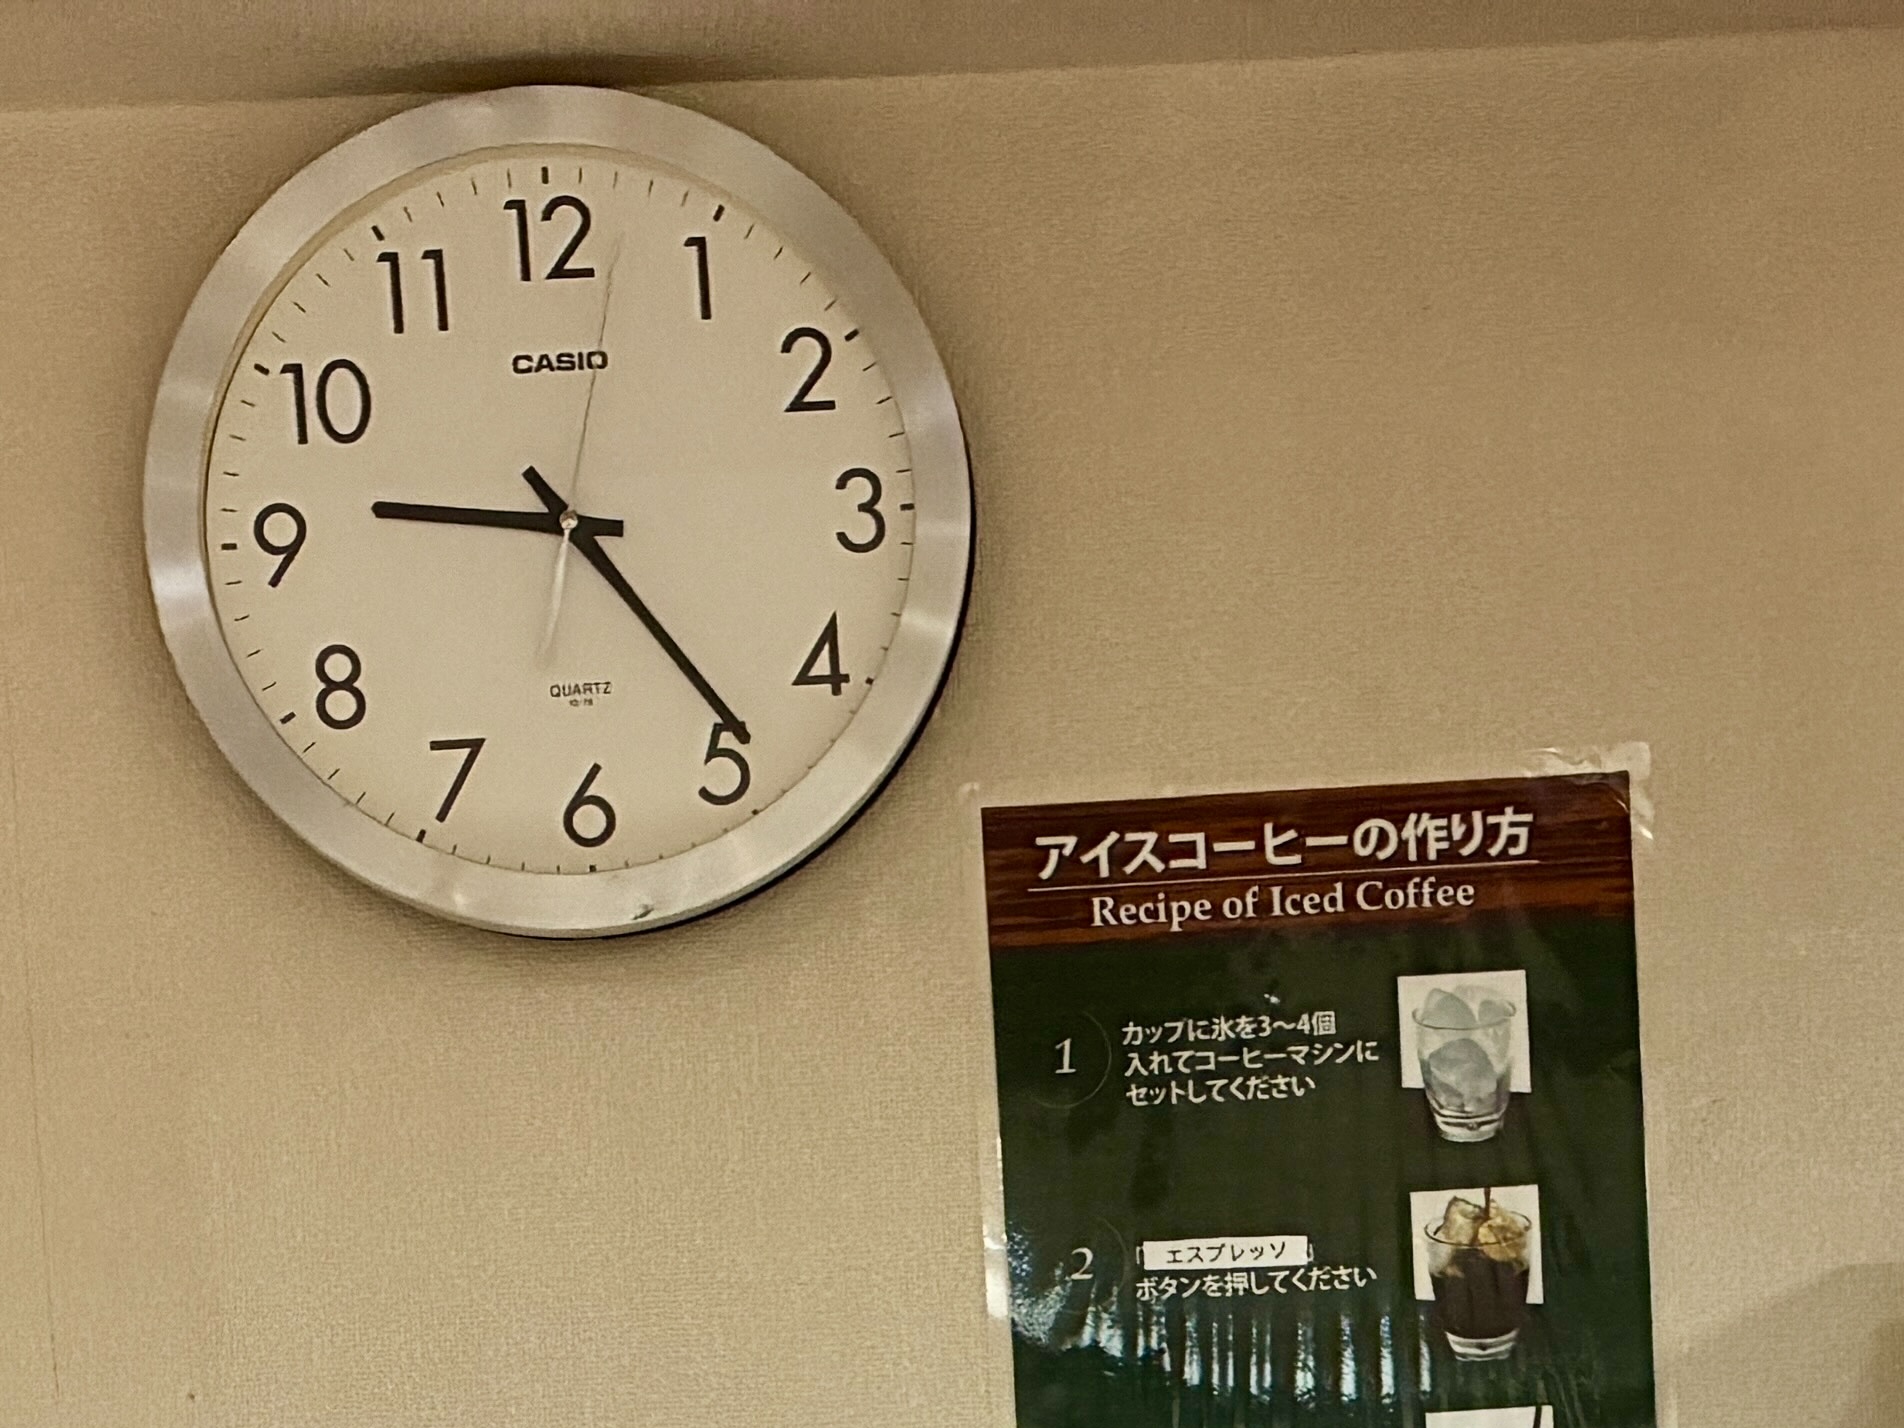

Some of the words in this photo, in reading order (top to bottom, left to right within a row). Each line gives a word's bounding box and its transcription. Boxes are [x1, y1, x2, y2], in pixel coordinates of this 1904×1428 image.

[504, 195, 595, 282] 12
[684, 236, 713, 320] 1
[377, 249, 450, 334] 11
[281, 359, 372, 445] 10
[512, 350, 609, 376] CASIO
[780, 326, 837, 413] 2
[253, 503, 307, 588] 9
[835, 467, 887, 553] 3
[314, 645, 367, 730] 8
[550, 681, 612, 698] QUARTZ
[792, 612, 851, 697] 4
[430, 738, 487, 823] 7
[563, 763, 617, 848] 6
[698, 721, 752, 806] 5
[1034, 806, 1534, 880] アイスコーヒーの作り方
[1090, 896, 1212, 932] Recipe
[1224, 888, 1258, 919] of
[1267, 883, 1345, 916] Iced
[1355, 878, 1475, 913] Coffee
[1054, 1037, 1077, 1075] 1
[1123, 1040, 1380, 1077] 入れてコーヒーマシンに
[1125, 1075, 1317, 1107] セットしてください
[1068, 1246, 1095, 1281] 2
[1134, 1266, 1378, 1300] ボタンを押してください
[1165, 1240, 1288, 1265] エスプレッソ
